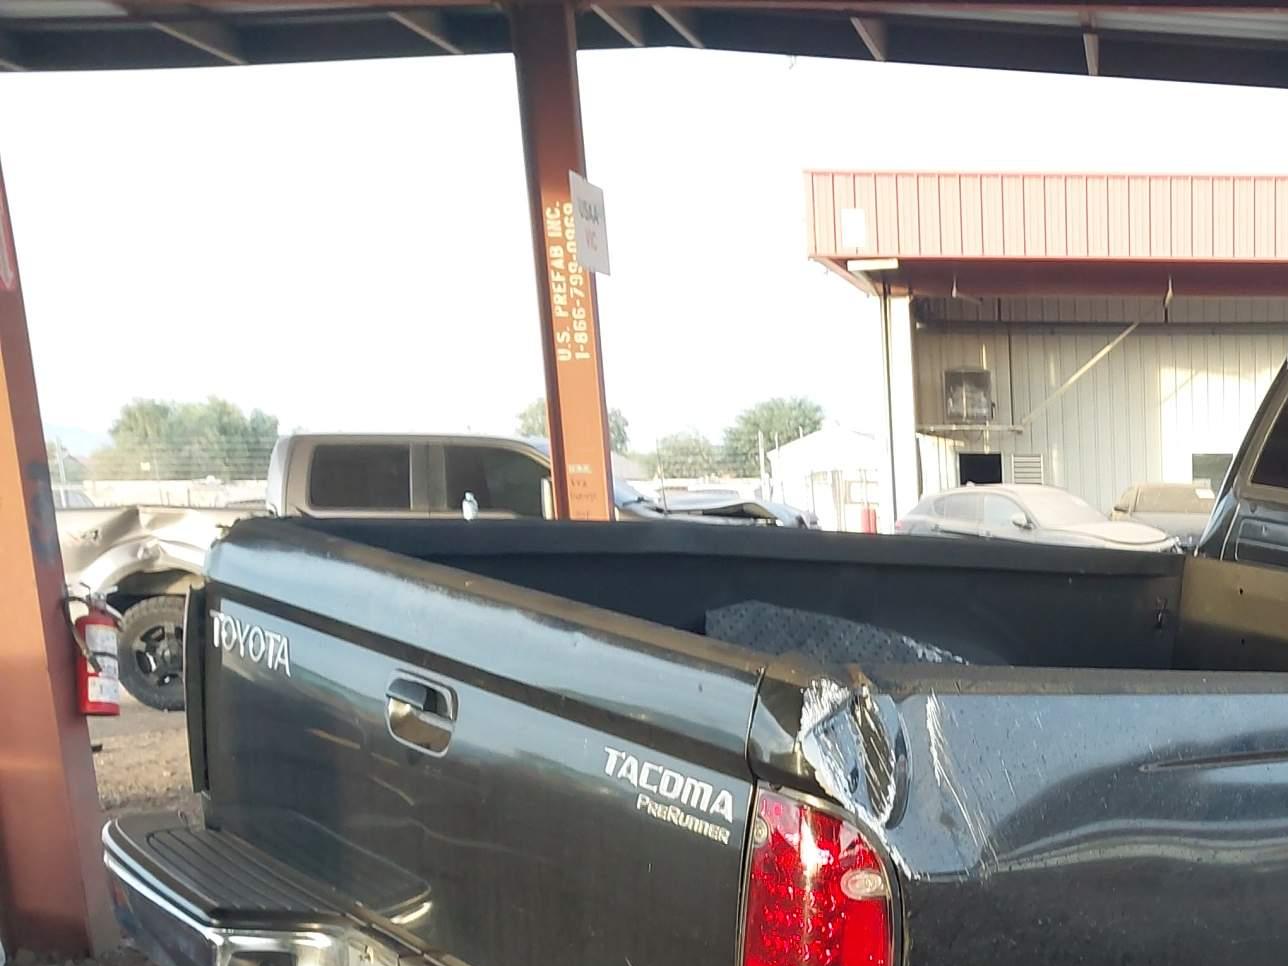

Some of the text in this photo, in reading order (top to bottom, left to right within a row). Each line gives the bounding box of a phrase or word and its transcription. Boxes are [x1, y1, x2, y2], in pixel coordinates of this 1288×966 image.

[545, 201, 572, 361] U.S. PREFAB INC.
[209, 609, 291, 678] TOYOTA
[605, 747, 733, 823] TACOMA
